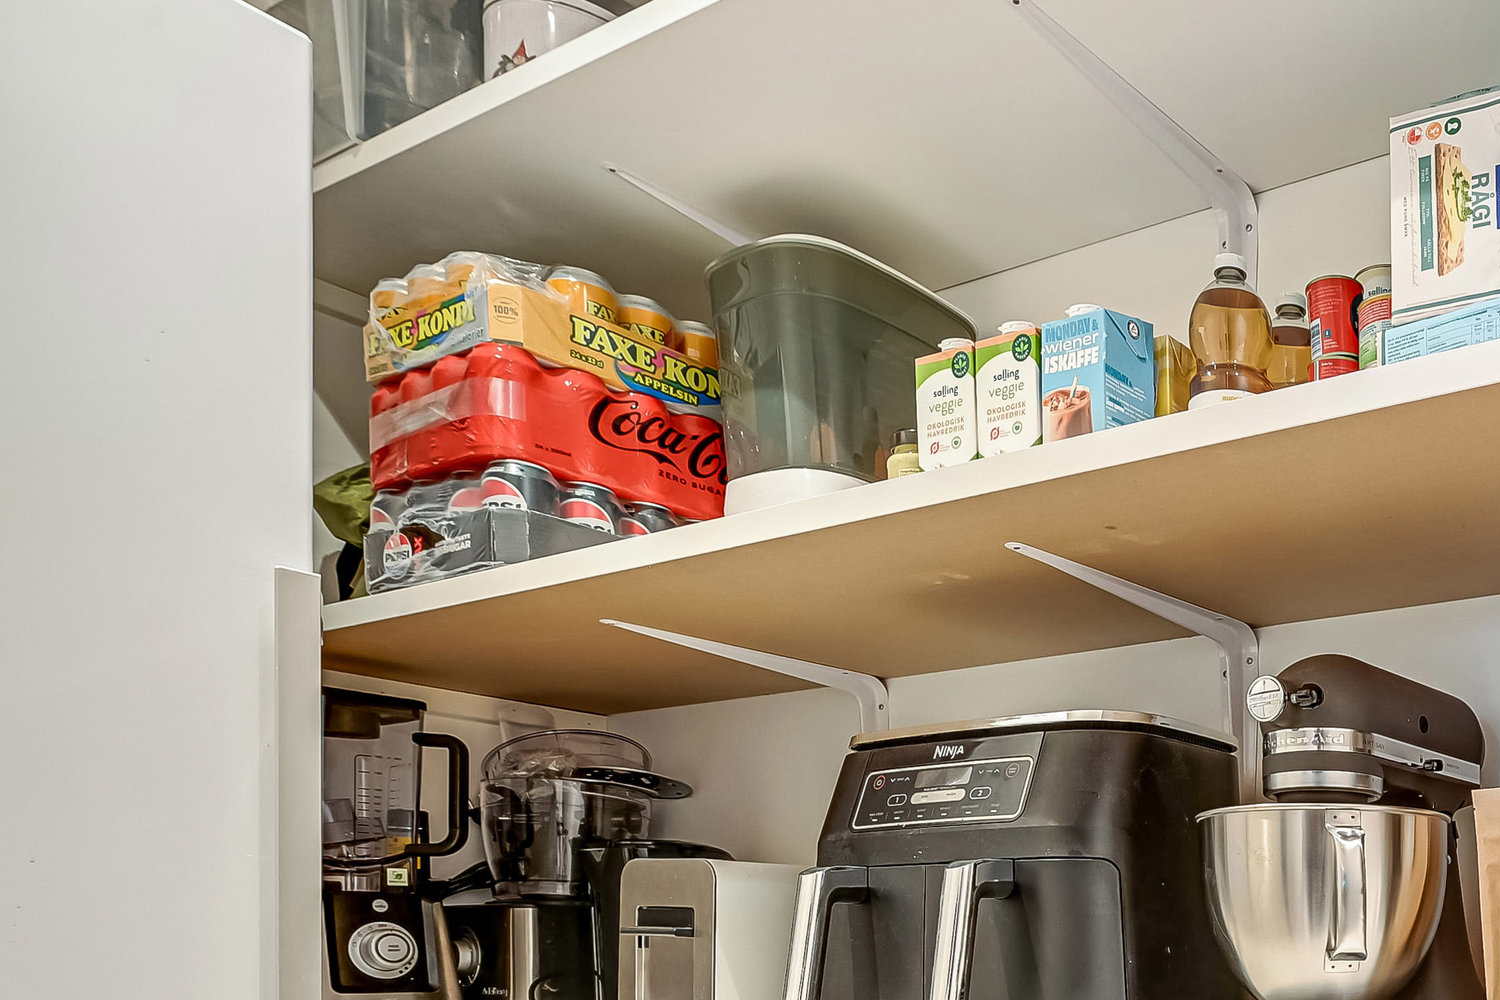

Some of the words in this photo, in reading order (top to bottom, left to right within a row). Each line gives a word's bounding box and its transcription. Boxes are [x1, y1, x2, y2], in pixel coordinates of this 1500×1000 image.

[1471, 173, 1495, 229] RÅGI
[493, 304, 519, 317] 100%
[587, 299, 617, 324] FAX
[624, 322, 666, 346] AXE
[1045, 317, 1091, 342] MONDAY
[1044, 332, 1099, 354] wiener
[571, 315, 657, 373] FAXE
[662, 353, 722, 400] KON
[1044, 346, 1099, 375] ISKAFFE
[993, 369, 1020, 382] salling
[634, 373, 699, 407] APPELSIN
[933, 385, 959, 398] salling
[988, 381, 1025, 401] veggie
[928, 398, 963, 417] veggie
[986, 408, 1027, 424] HAVREDRIK
[658, 469, 688, 486] ZERO
[691, 481, 723, 497] SUGA
[933, 745, 964, 760] NINJA
